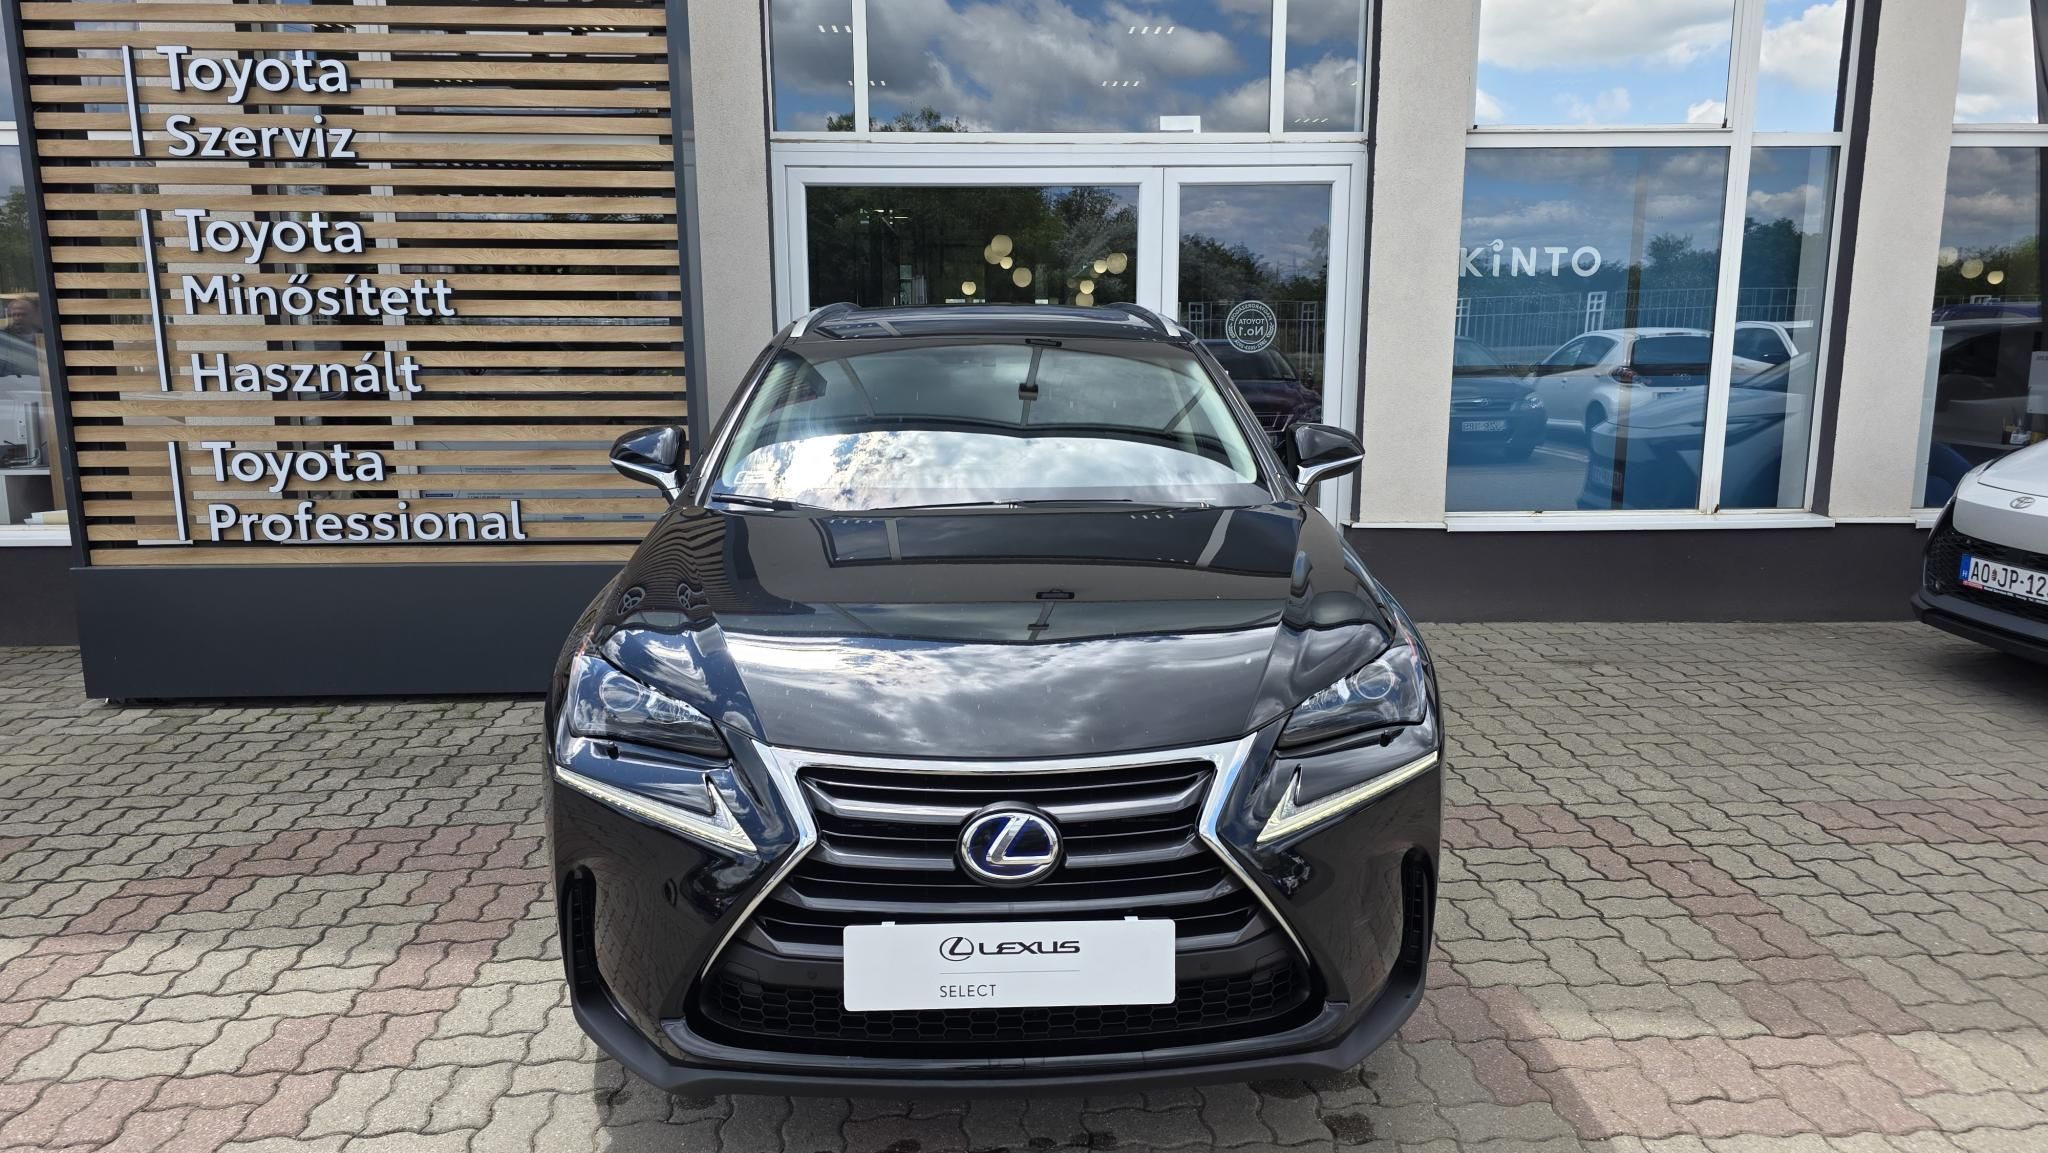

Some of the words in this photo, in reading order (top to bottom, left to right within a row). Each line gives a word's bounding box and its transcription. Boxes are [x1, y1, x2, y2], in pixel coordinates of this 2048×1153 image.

[155, 45, 351, 104] Toyota
[165, 114, 359, 160] Szerviz
[174, 208, 365, 265] Toyota
[181, 273, 456, 317] Minősített
[191, 351, 423, 395] Használt
[201, 441, 387, 493] Toyota
[208, 500, 527, 543] Professional
[1998, 567, 2048, 597] JP-12
[978, 940, 1081, 955] LEXUS
[939, 984, 997, 998] SELECT
